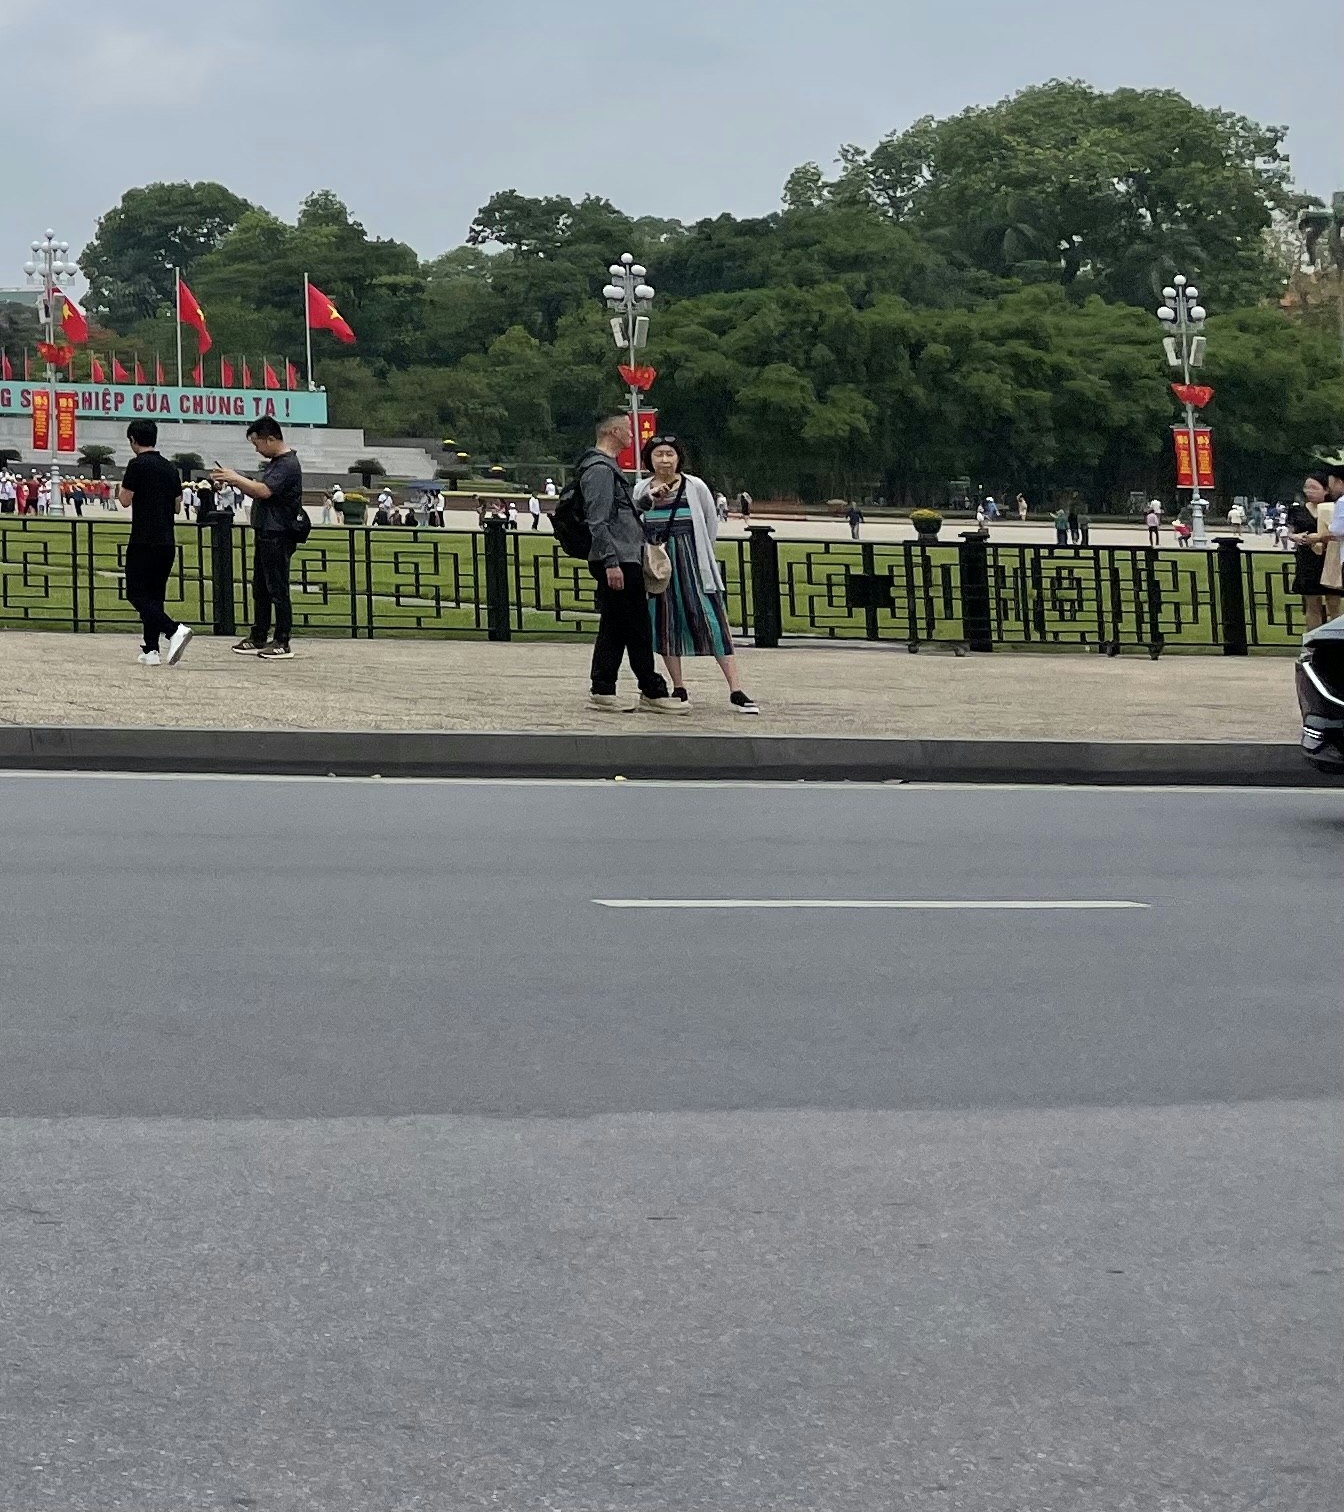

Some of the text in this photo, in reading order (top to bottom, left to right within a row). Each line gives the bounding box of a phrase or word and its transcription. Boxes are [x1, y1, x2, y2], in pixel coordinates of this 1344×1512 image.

[132, 386, 171, 413] CỦA
[179, 390, 245, 416] CHÚNG
[252, 396, 276, 416] TA
[284, 397, 291, 417] !
